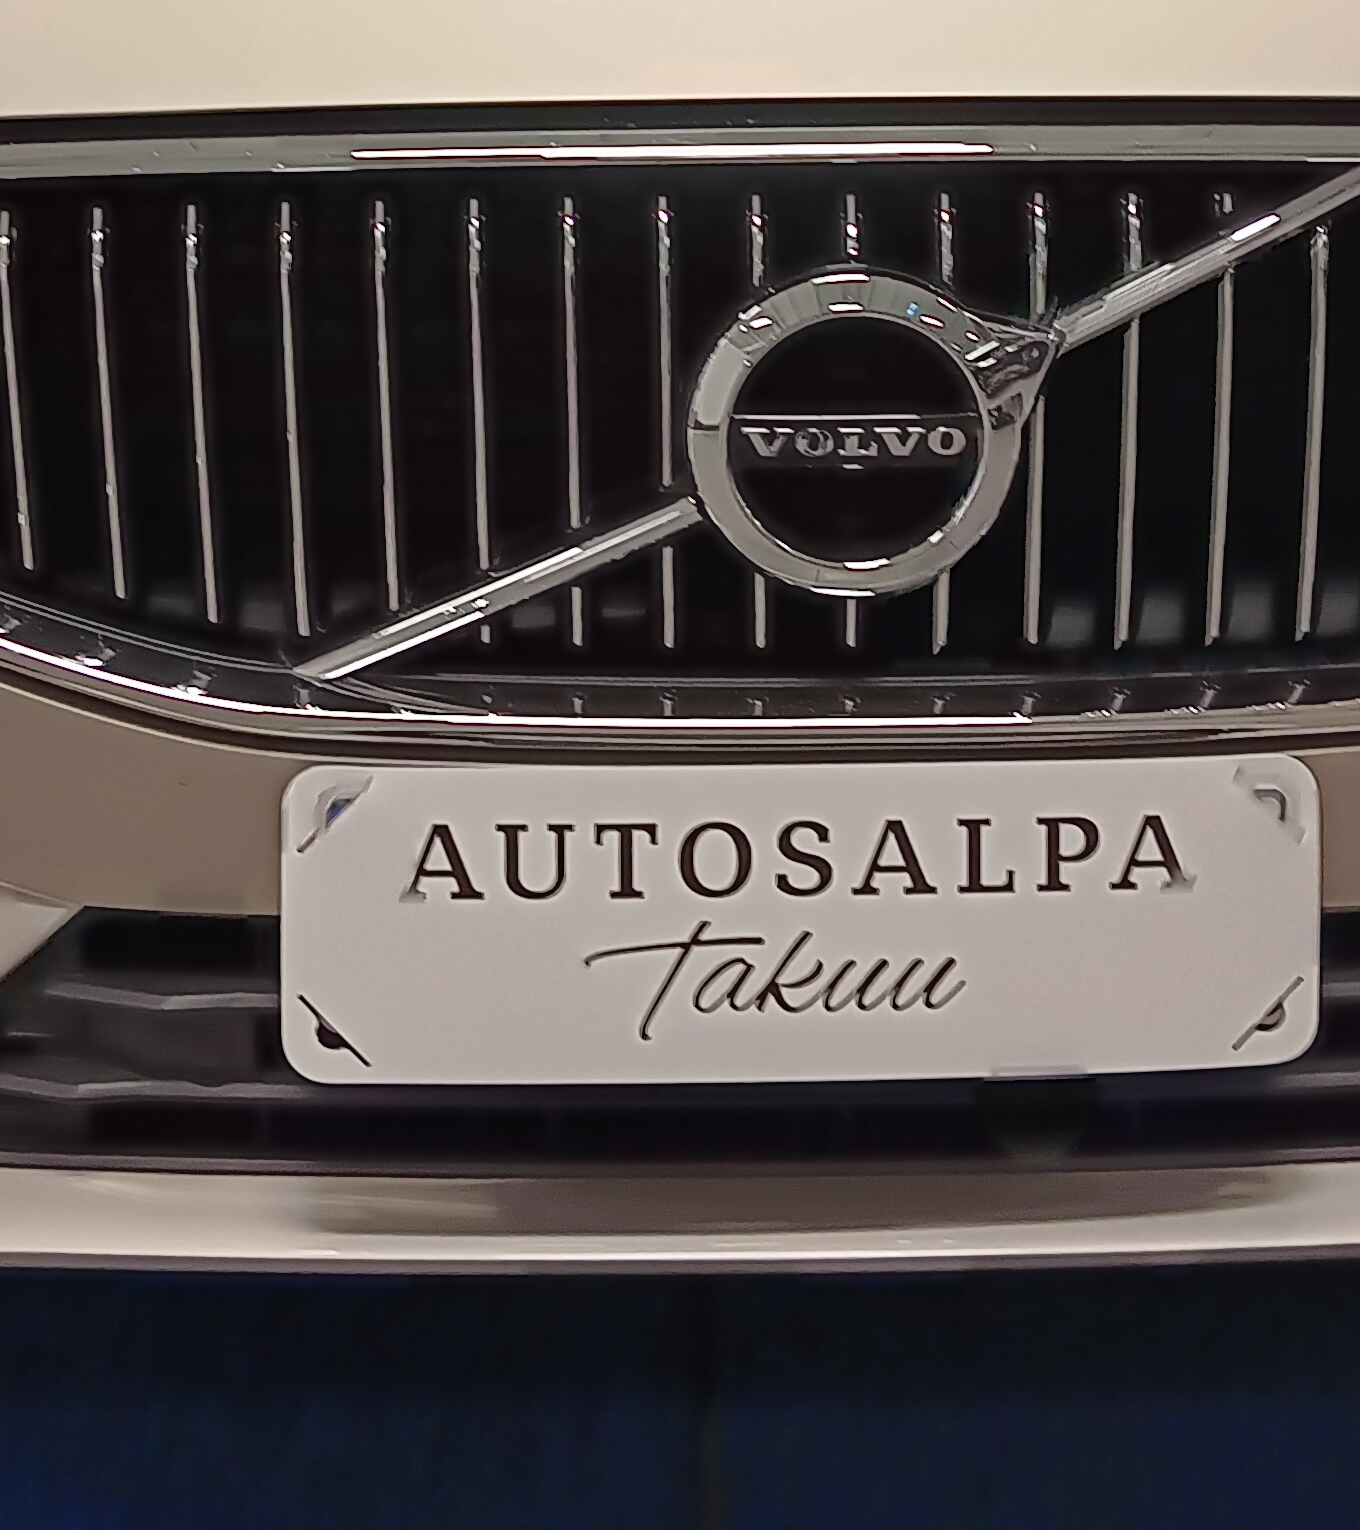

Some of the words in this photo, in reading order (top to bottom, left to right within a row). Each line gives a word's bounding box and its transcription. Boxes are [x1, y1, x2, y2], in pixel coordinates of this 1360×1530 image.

[741, 425, 967, 457] VOLVO
[400, 815, 1196, 902] AUTOSALPA
[583, 920, 967, 1041] Takuu
